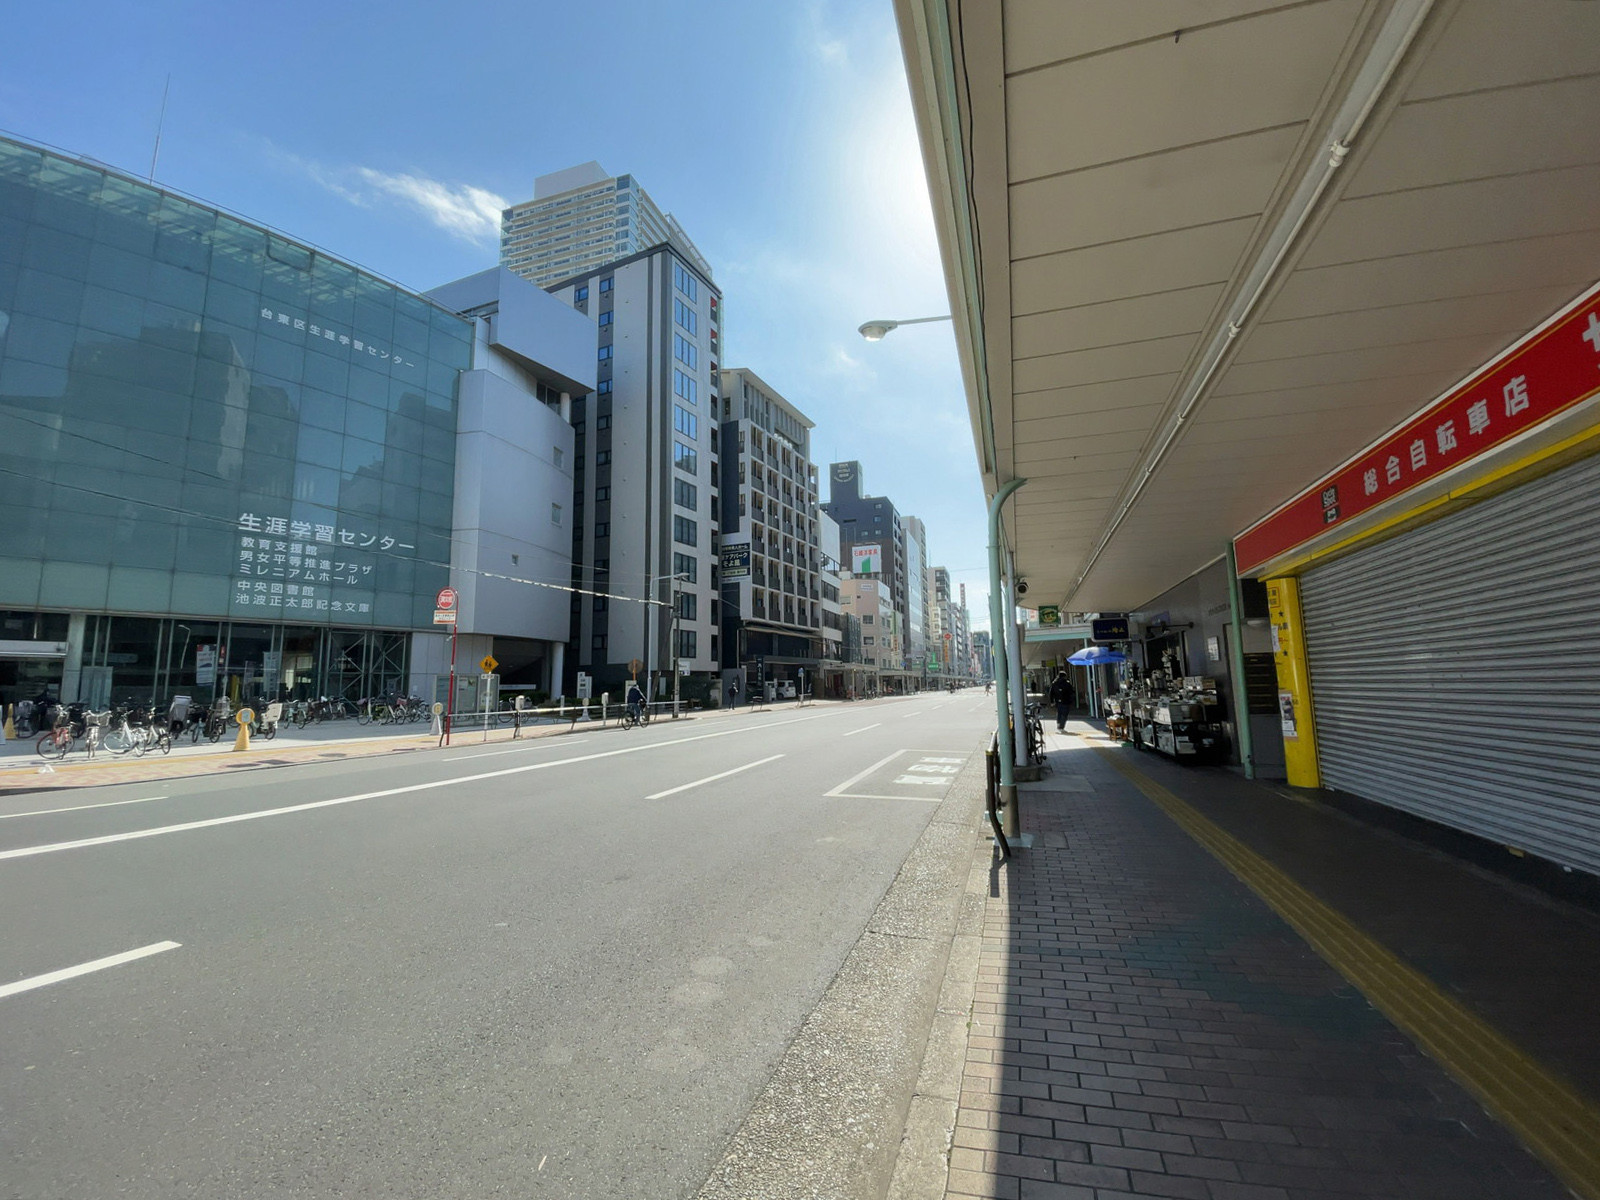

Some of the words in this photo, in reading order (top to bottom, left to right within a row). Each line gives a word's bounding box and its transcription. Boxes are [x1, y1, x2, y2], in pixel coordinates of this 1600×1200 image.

[261, 308, 415, 367] 台東区生涯学習センター
[1363, 374, 1531, 496] 総合自転車店
[238, 513, 415, 550] 生涯学習センター
[241, 536, 318, 556] 教育支援館
[239, 550, 373, 575] 男女平等推進プラザ
[239, 563, 358, 585] ミレニアムホール
[237, 580, 315, 597] 中央図書館
[235, 593, 370, 613] 池波正太郎記念文庫
